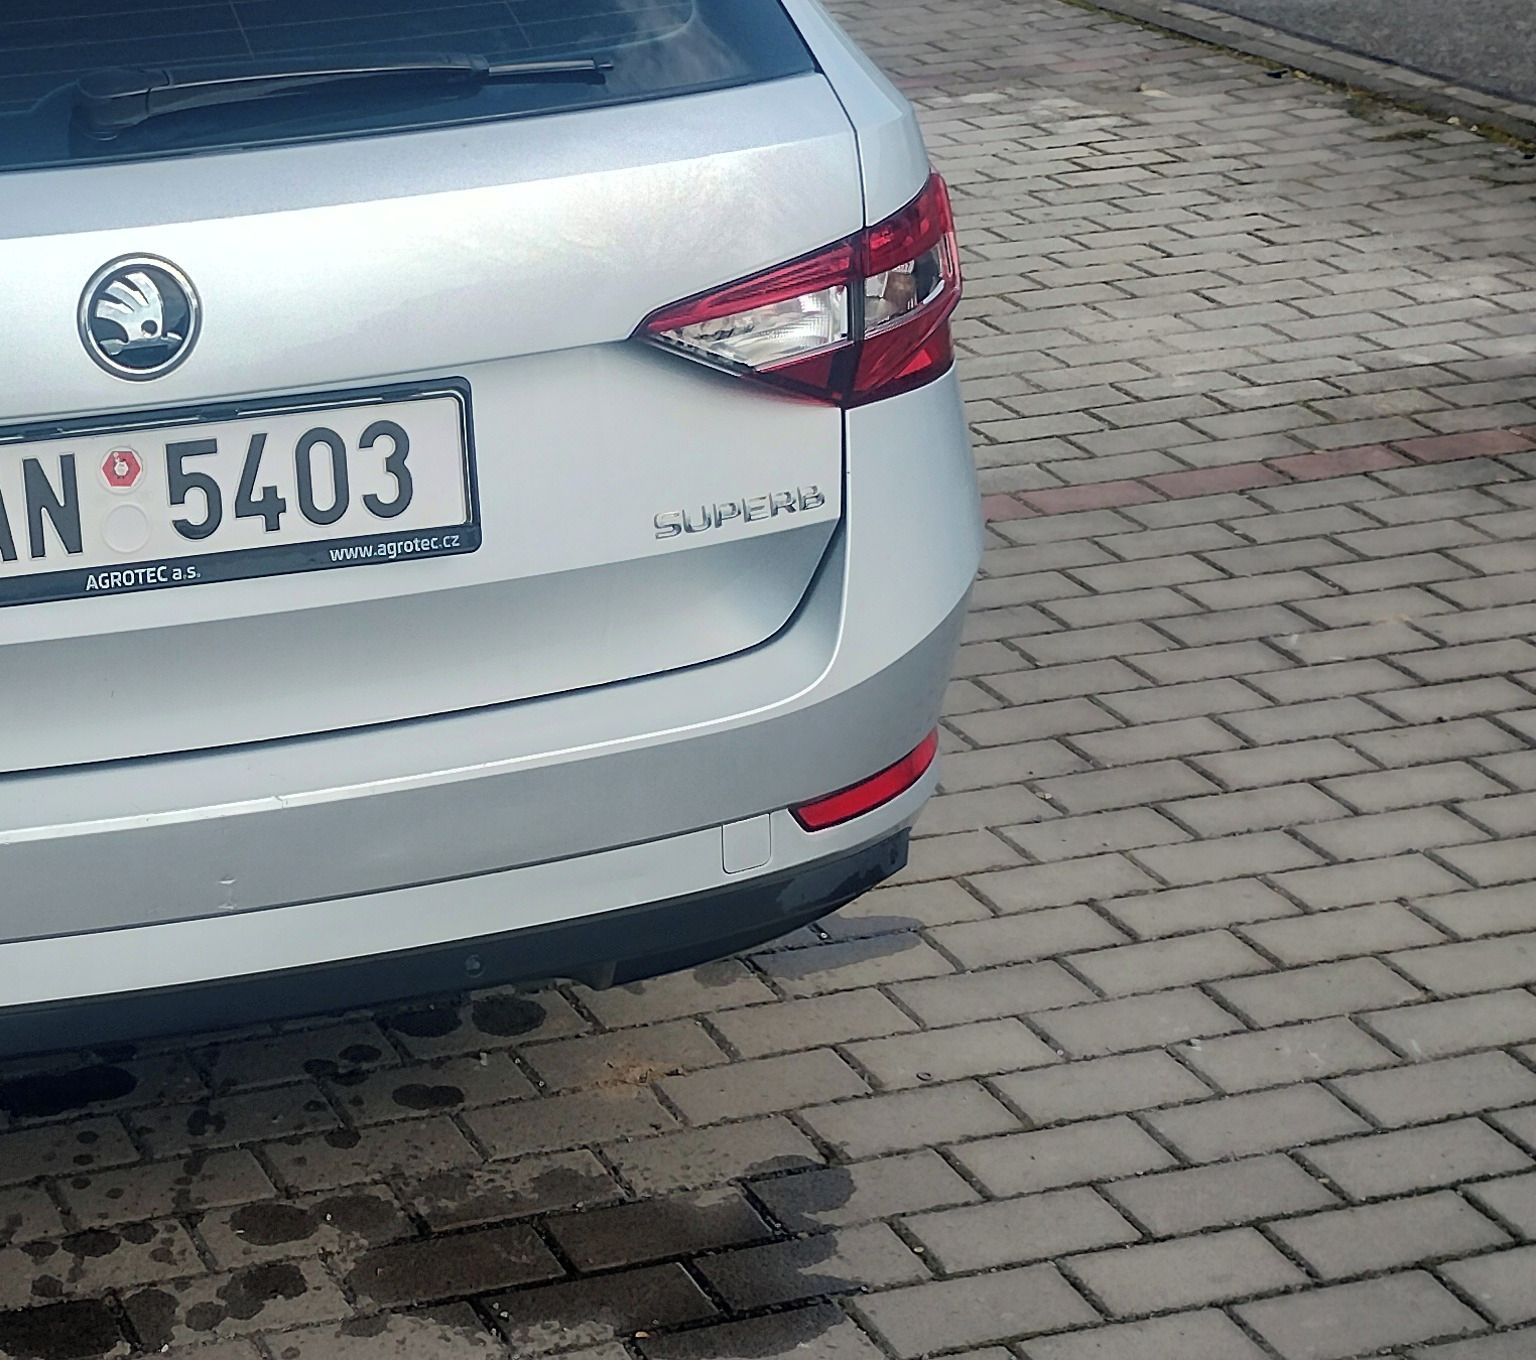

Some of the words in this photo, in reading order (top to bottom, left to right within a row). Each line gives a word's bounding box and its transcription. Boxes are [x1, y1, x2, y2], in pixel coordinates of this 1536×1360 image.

[165, 419, 414, 540] 5403
[653, 484, 826, 540] SUPERB
[329, 534, 461, 562] www.agrotec.cz
[85, 566, 169, 591] AGROTEC
[172, 566, 201, 581] a.s.
